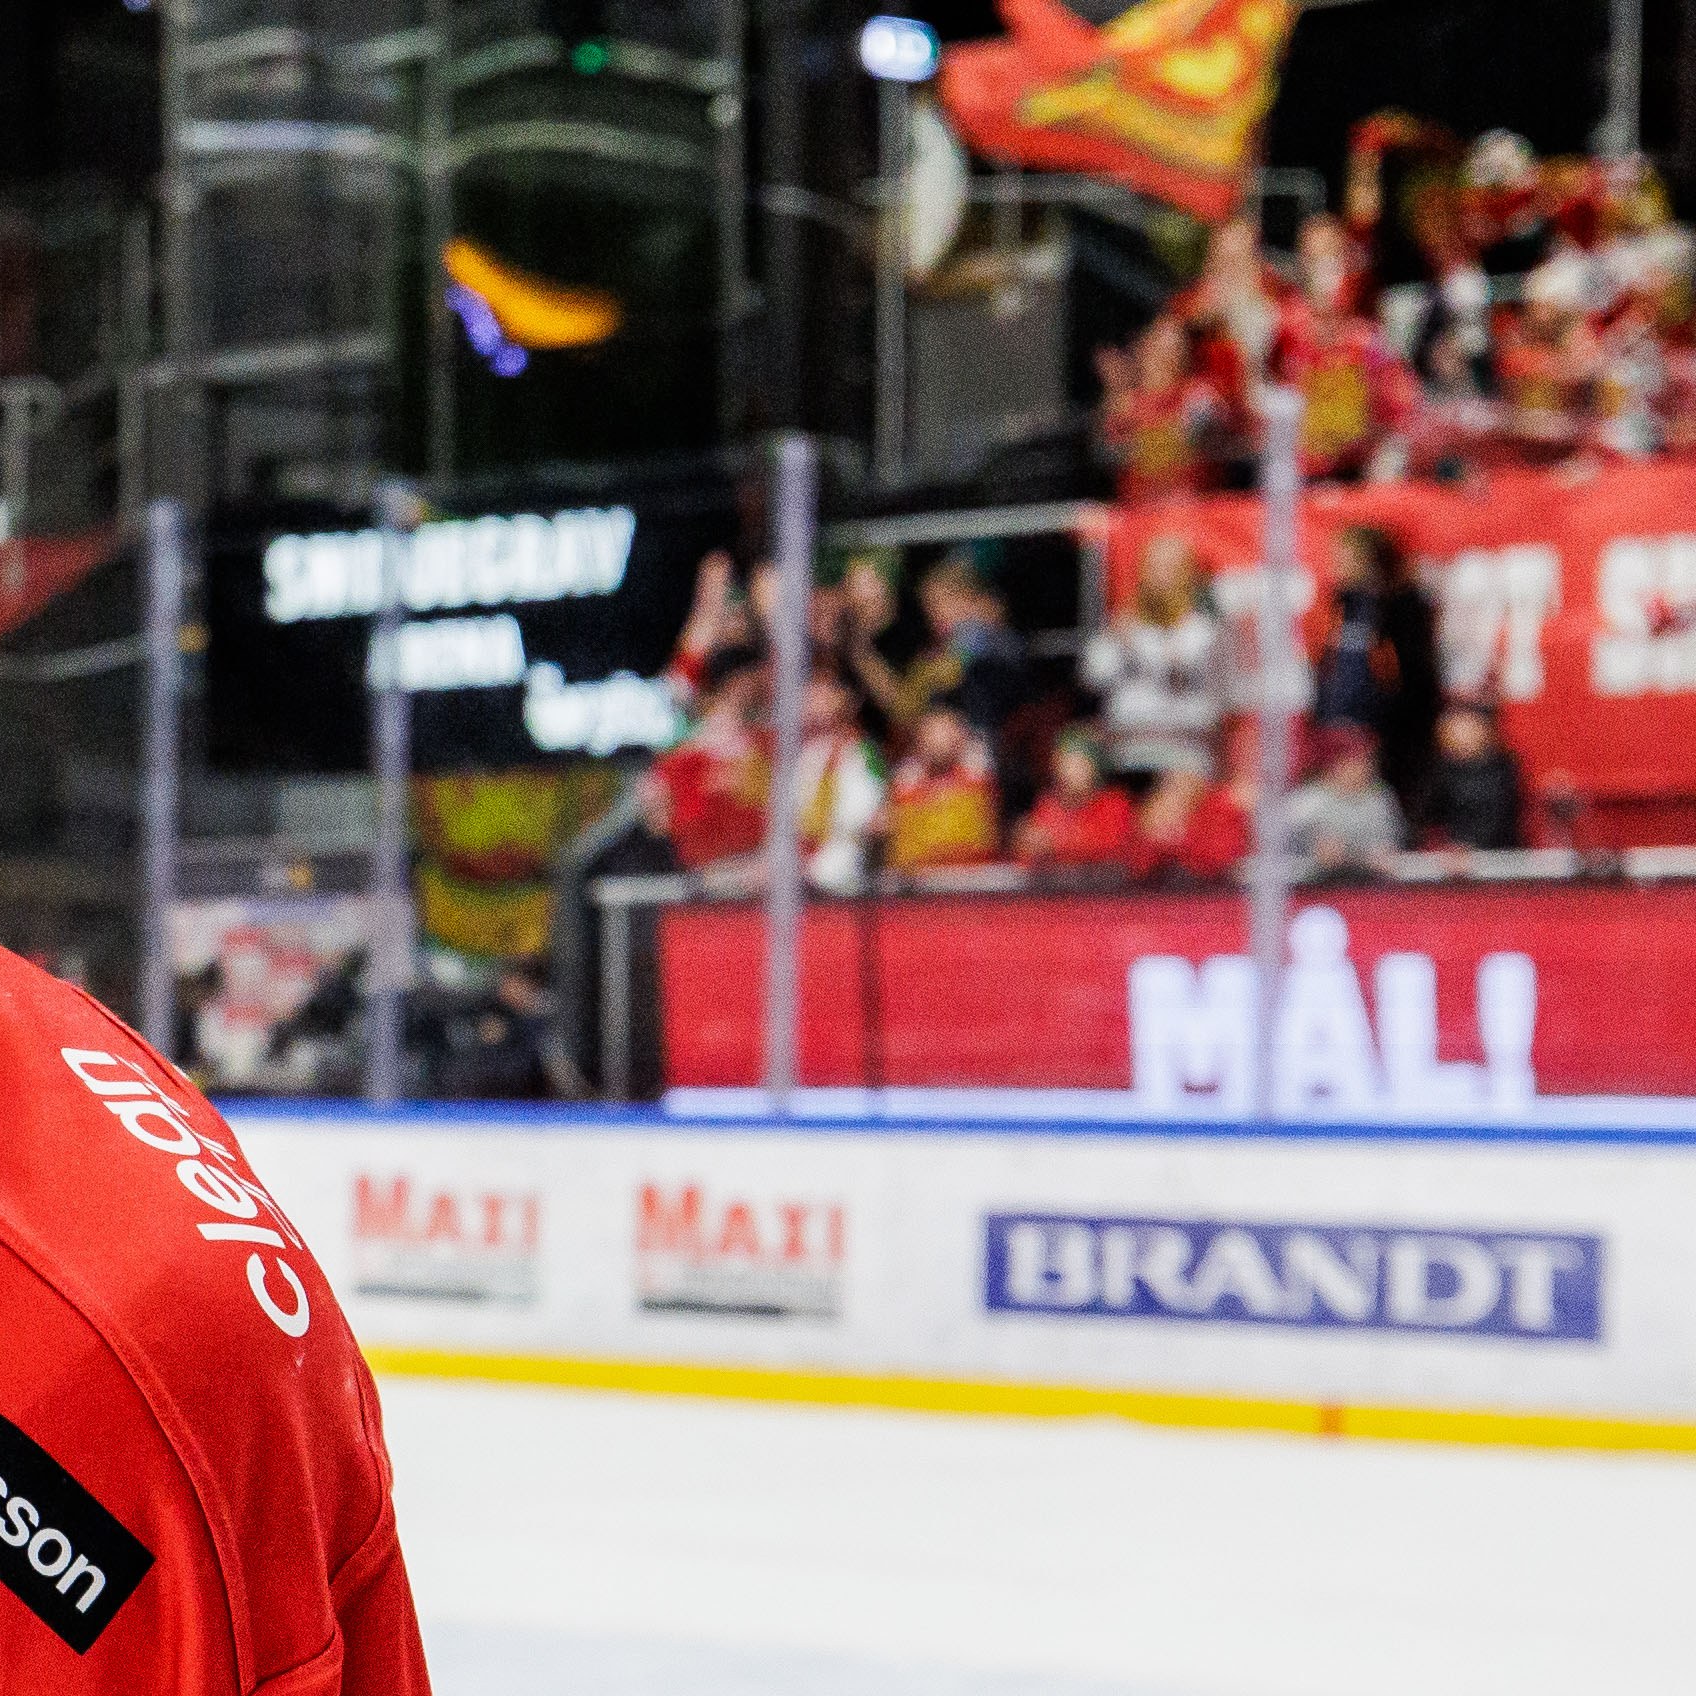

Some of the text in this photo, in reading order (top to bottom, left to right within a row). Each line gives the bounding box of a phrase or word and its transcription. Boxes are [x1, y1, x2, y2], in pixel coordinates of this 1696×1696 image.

[1128, 906, 1539, 1121] MÅL!
[61, 1046, 309, 1339] clean
[1007, 1221, 1585, 1334] BRANDT
